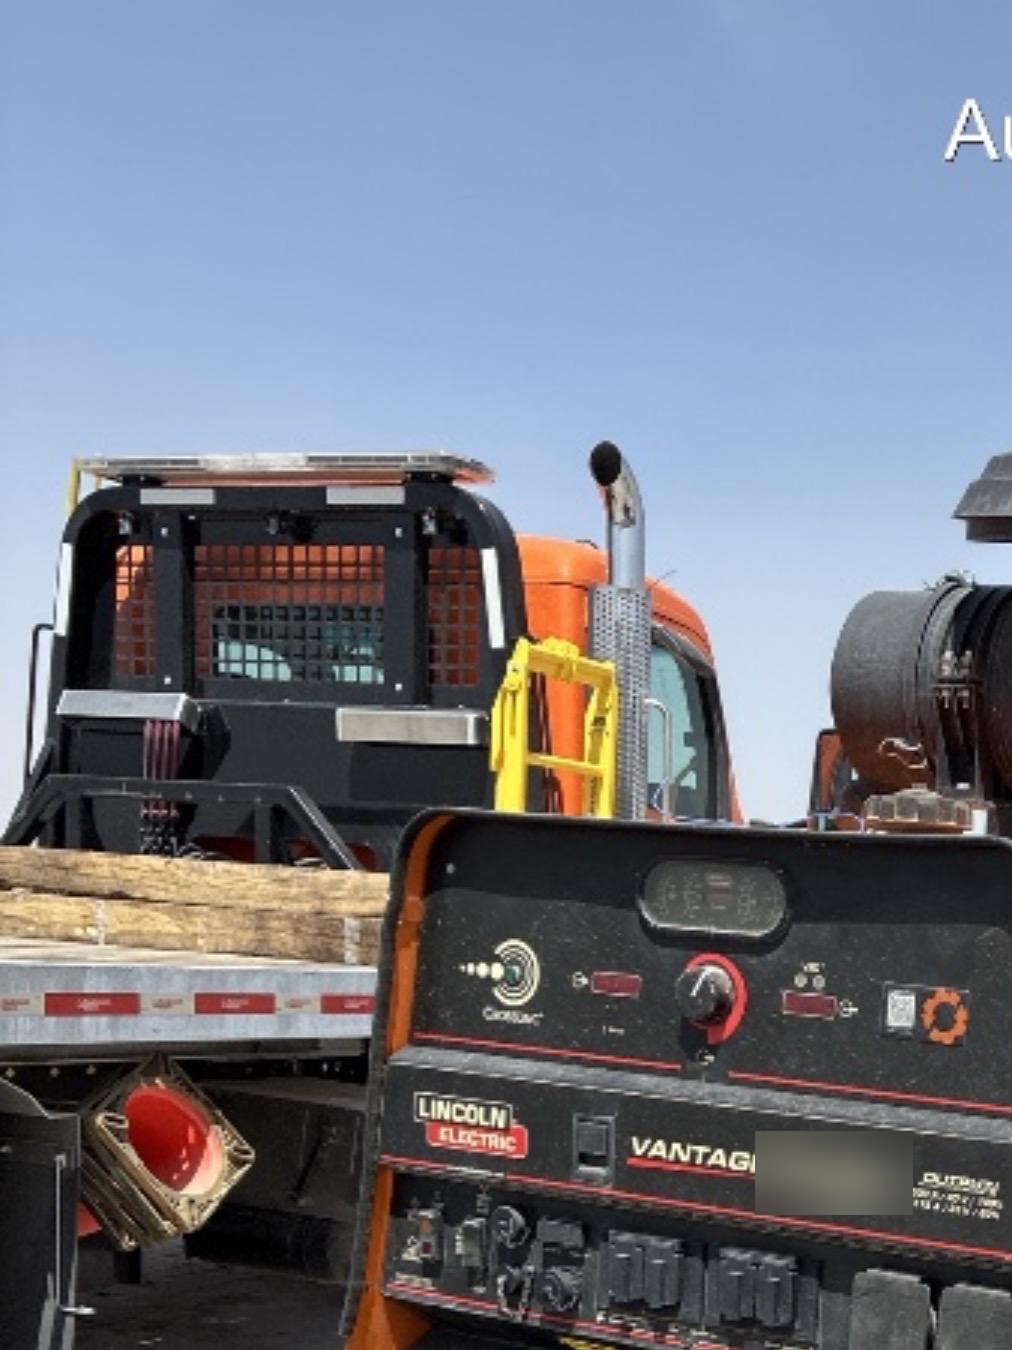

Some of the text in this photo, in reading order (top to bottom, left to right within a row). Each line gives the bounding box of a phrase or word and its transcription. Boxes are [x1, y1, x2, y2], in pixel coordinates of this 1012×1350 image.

[418, 1096, 507, 1130] LINCOLN
[439, 1126, 518, 1154] ELECTRIC
[630, 1135, 756, 1174] VANTAG
